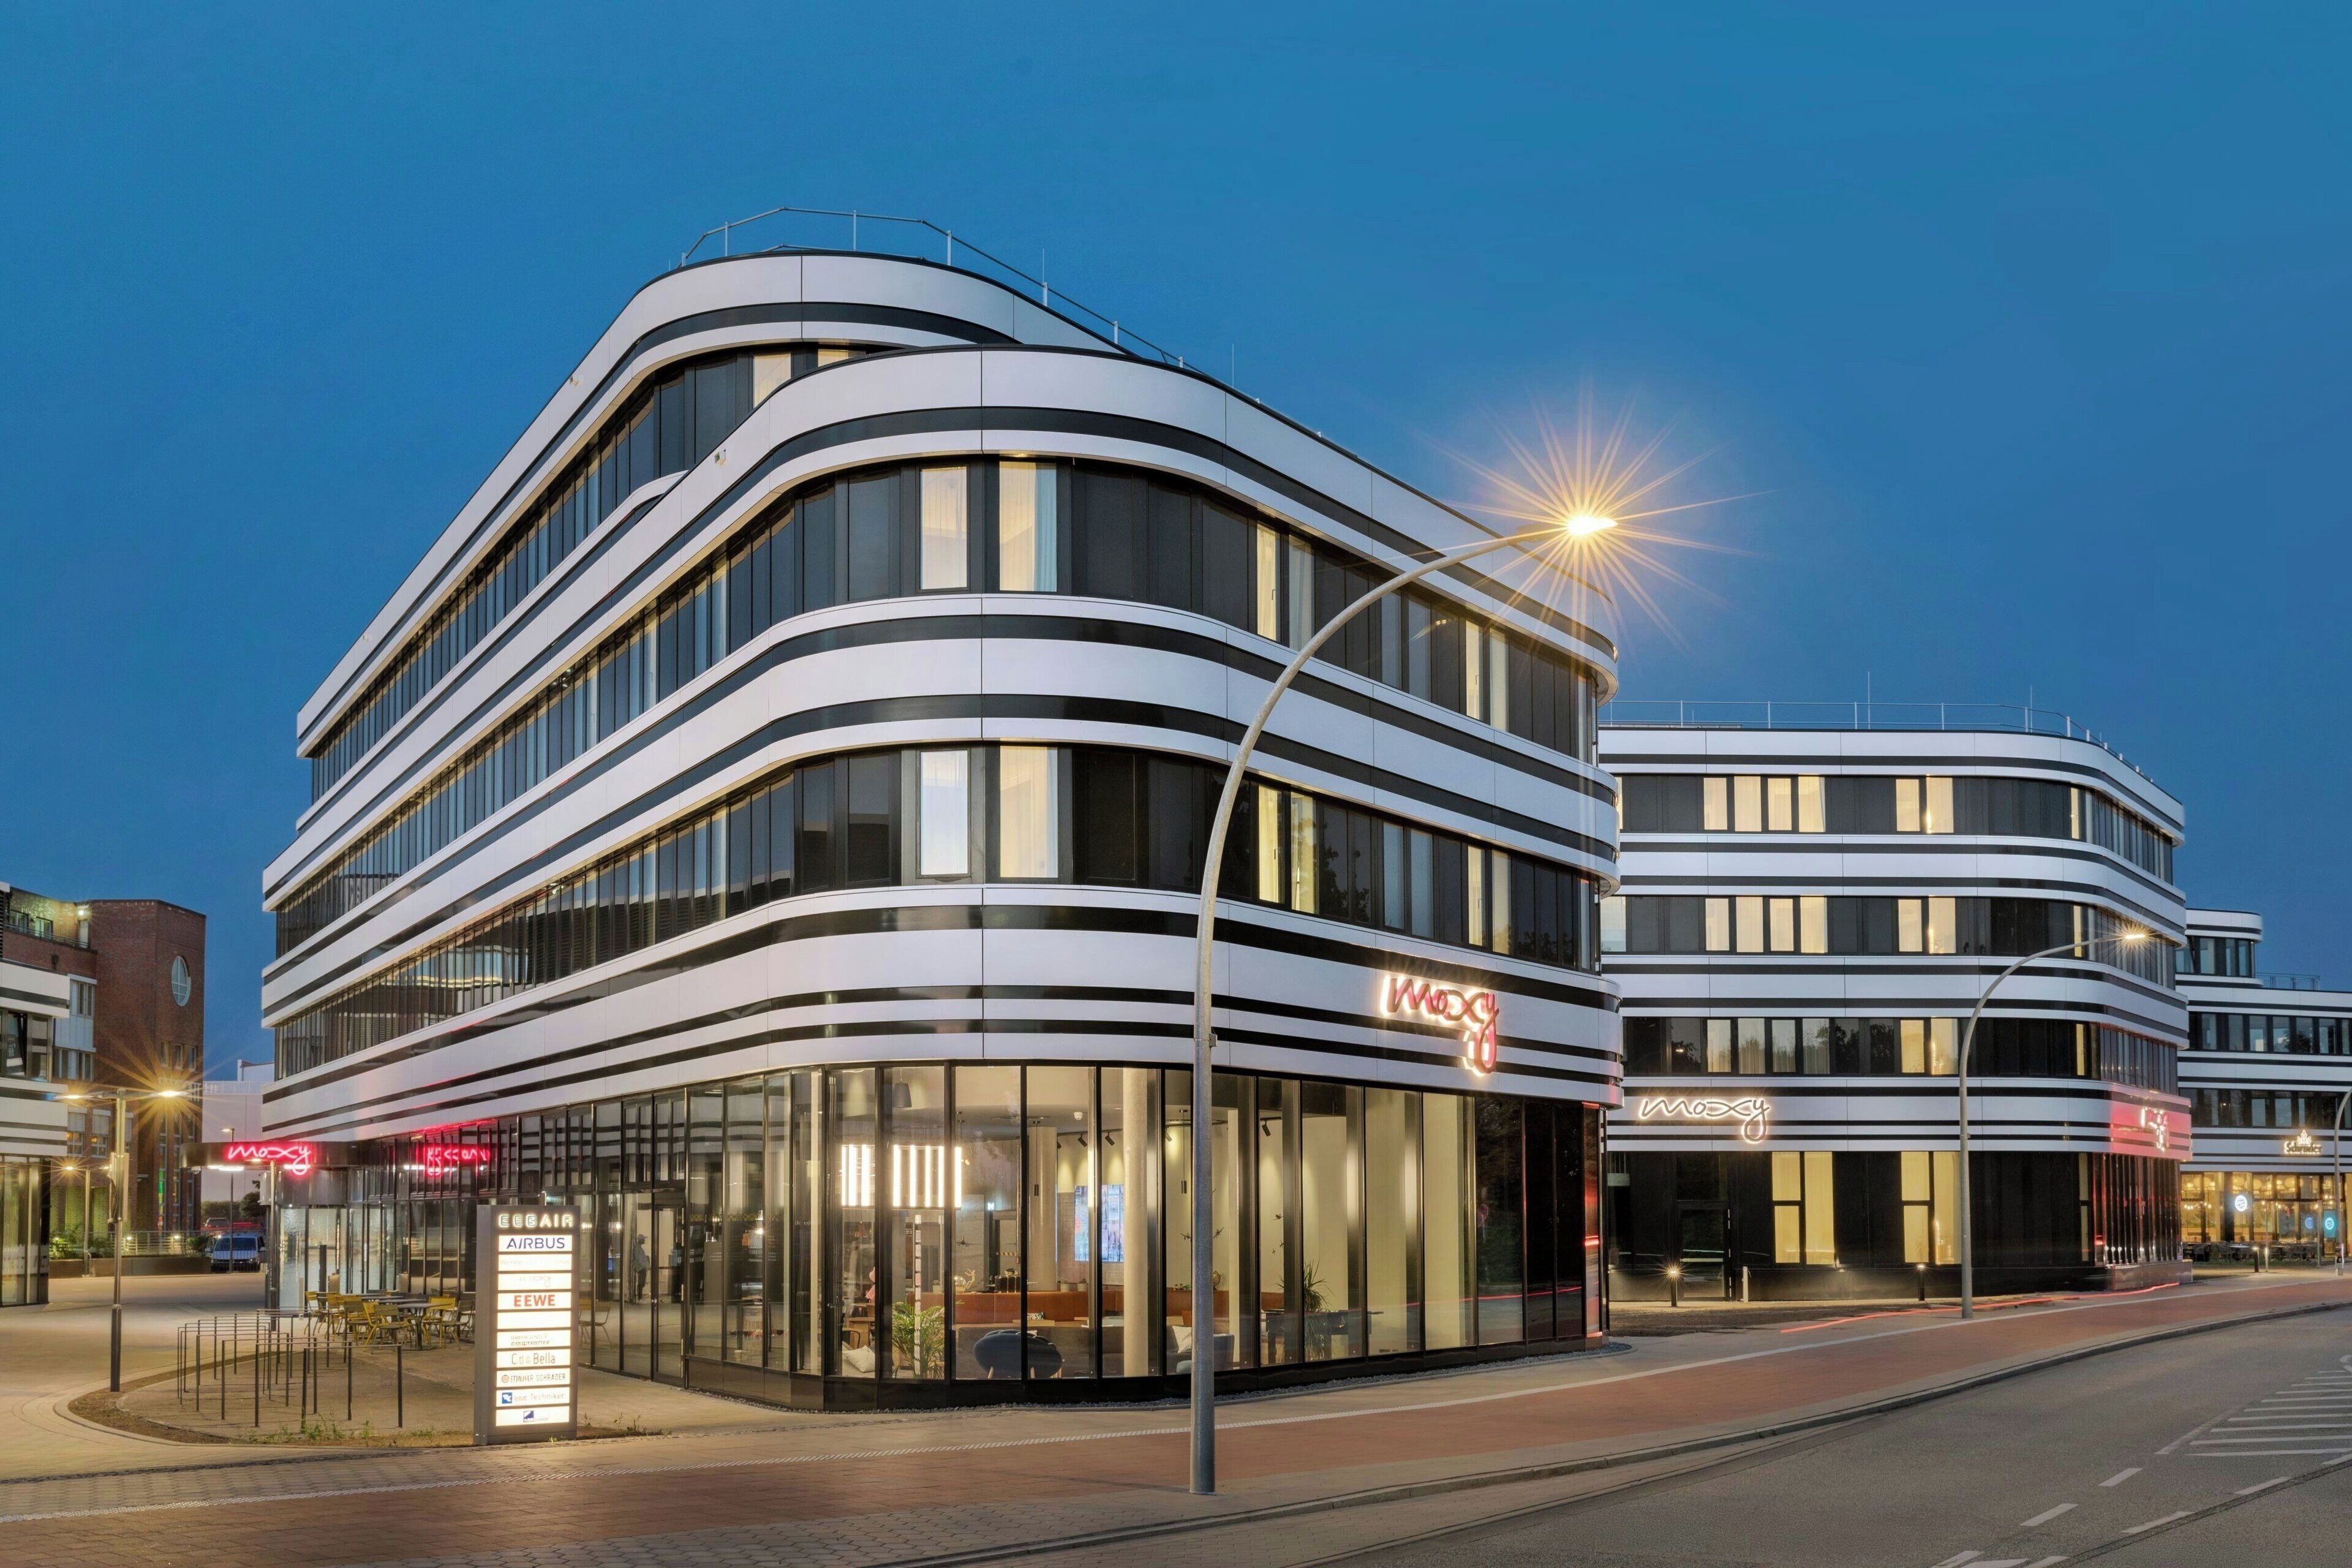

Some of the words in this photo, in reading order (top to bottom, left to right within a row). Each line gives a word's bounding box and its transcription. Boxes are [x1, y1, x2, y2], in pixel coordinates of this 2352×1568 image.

[1383, 976, 1500, 1075] moxy
[1640, 1098, 1770, 1143] moxy
[227, 1145, 312, 1175] moxy
[507, 1237, 565, 1250] AIRBUS
[533, 1352, 556, 1365] Bella
[530, 1393, 564, 1401] Techniker
